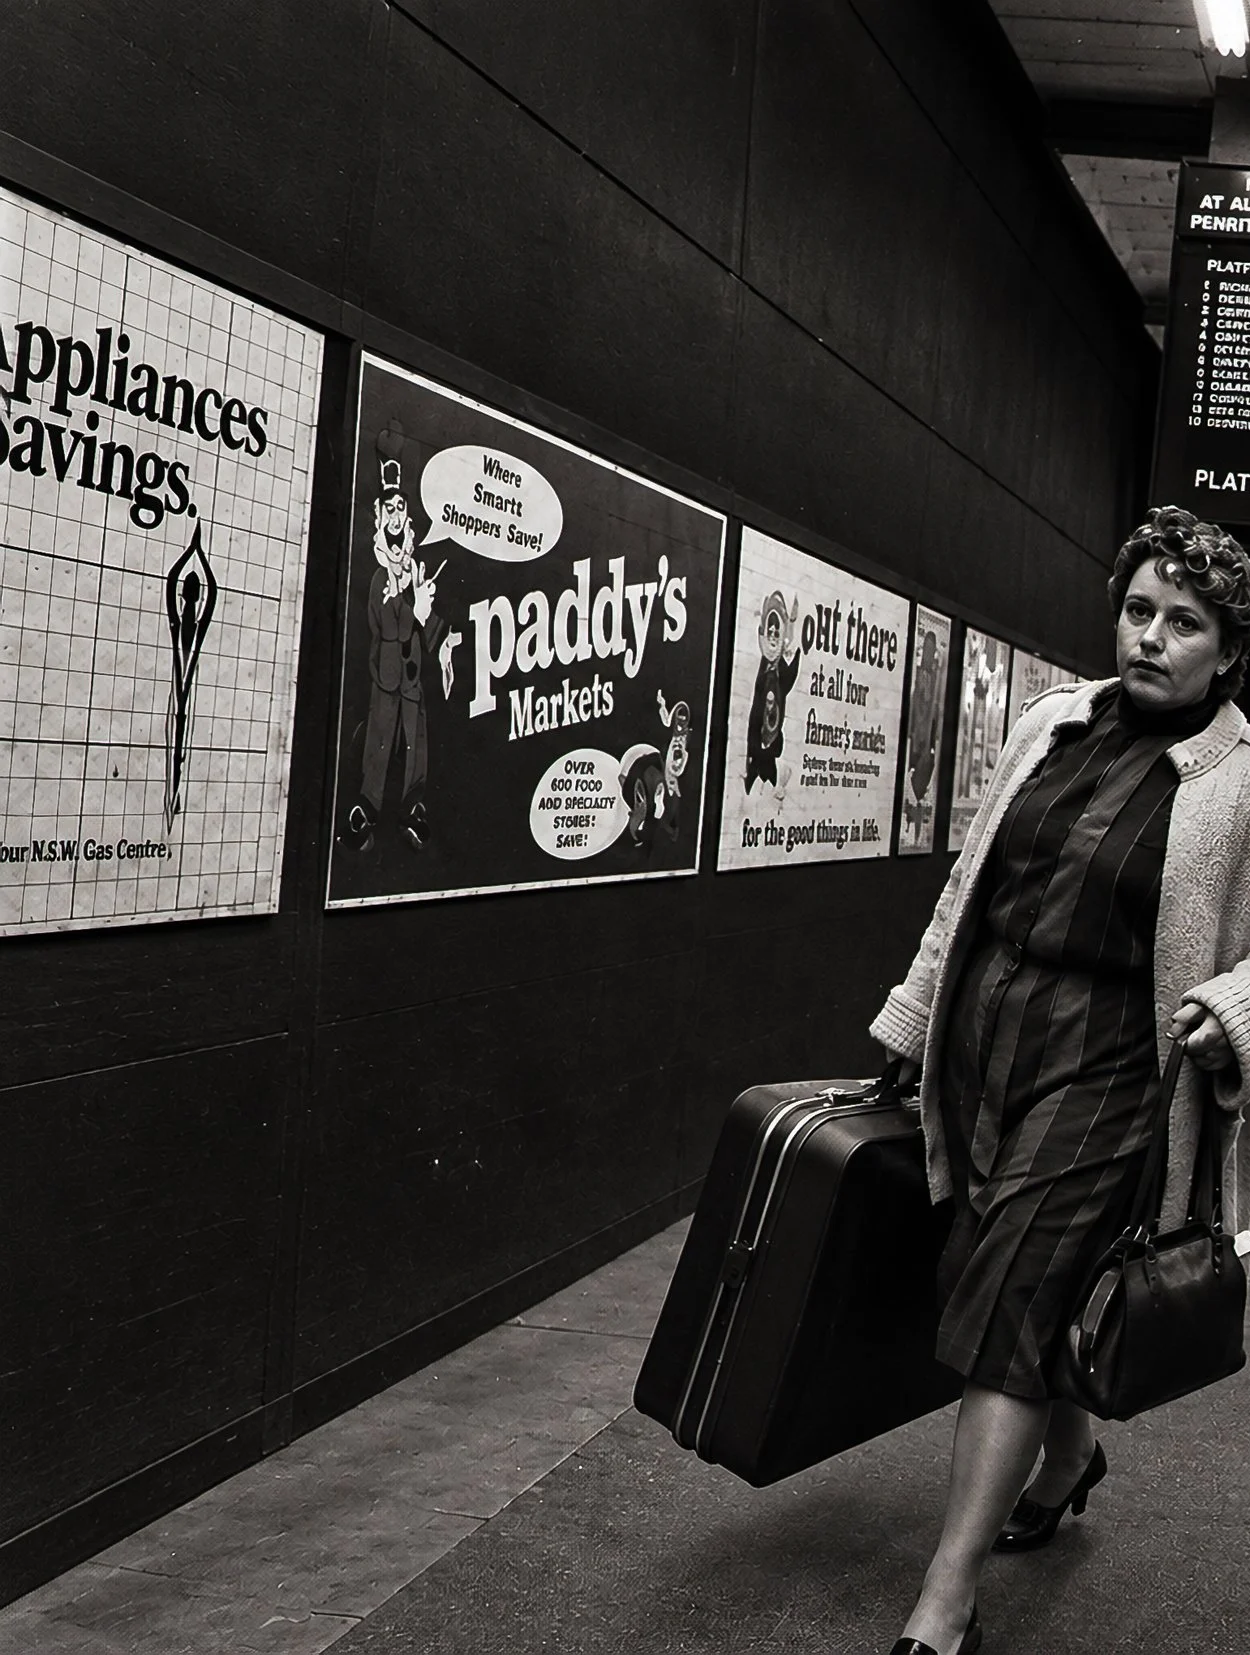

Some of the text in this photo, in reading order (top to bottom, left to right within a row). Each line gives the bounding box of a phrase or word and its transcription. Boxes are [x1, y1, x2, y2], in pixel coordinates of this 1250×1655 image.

[1199, 194, 1225, 210] AT
[482, 453, 523, 489] Where
[441, 503, 544, 553] Shoppers Save!
[469, 554, 688, 719] paddy's
[845, 600, 899, 671] there
[809, 664, 826, 698] at
[827, 668, 845, 701] all
[508, 673, 614, 742] Markets
[0, 841, 29, 862] our
[31, 840, 80, 862] N.S.W.
[83, 838, 115, 861] Gas
[741, 818, 762, 848] for
[764, 818, 786, 847] the
[785, 819, 816, 853] good
